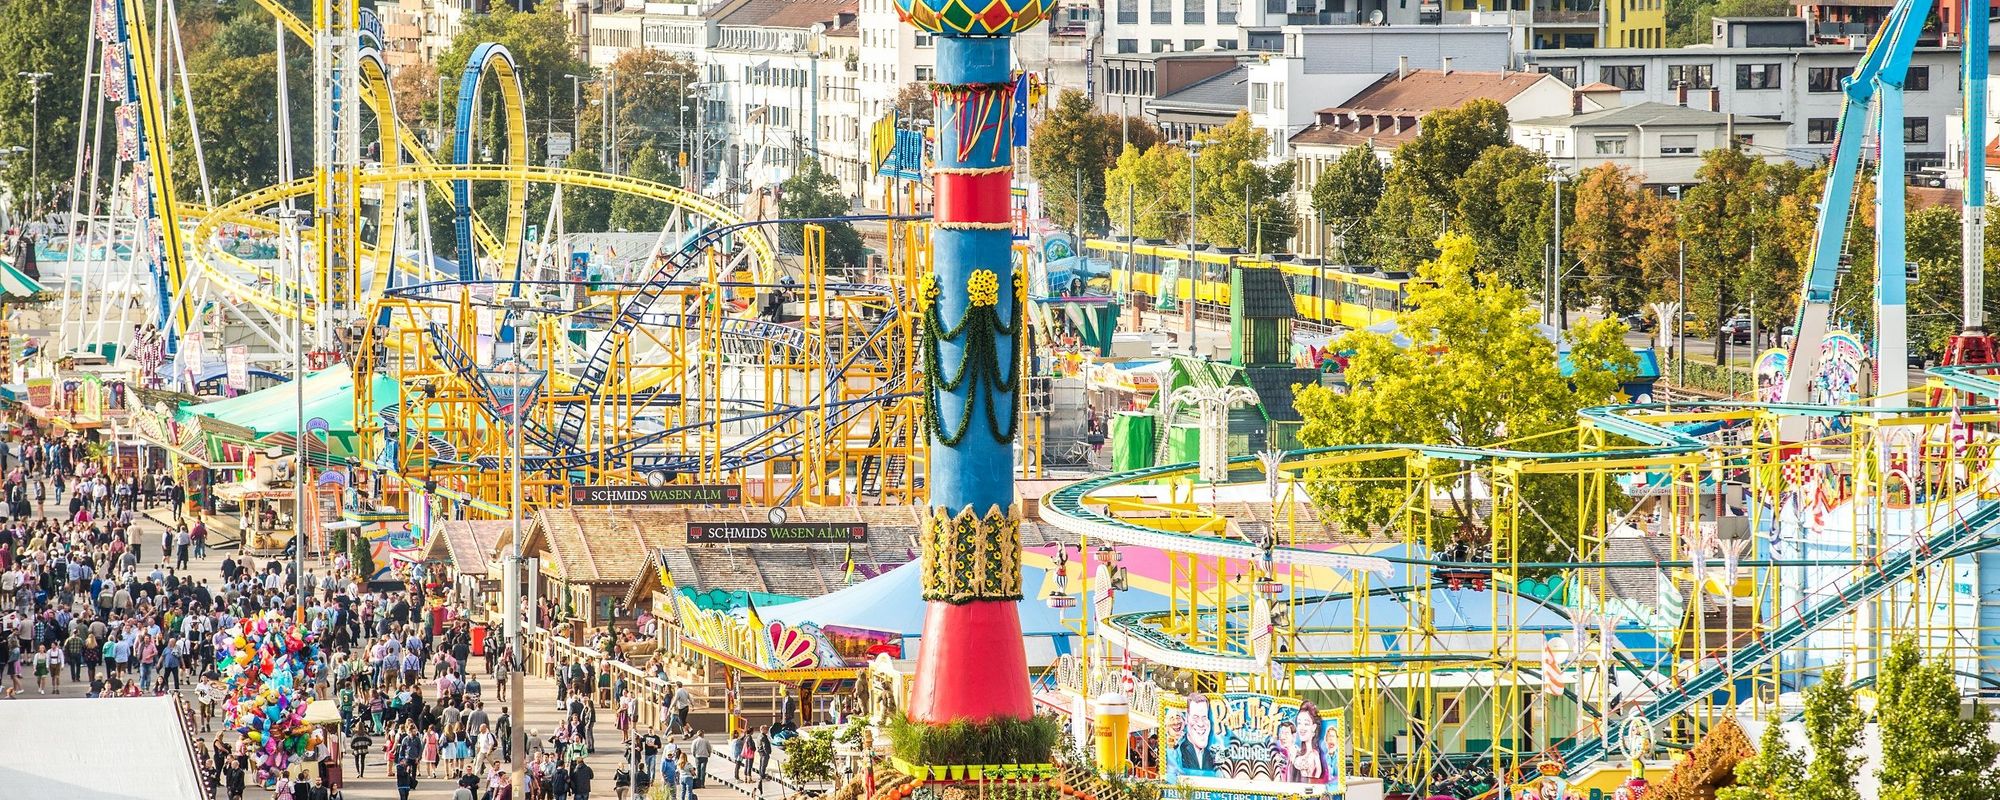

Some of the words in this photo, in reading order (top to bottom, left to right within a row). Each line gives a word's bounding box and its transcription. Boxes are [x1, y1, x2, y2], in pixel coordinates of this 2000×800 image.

[591, 490, 647, 501] SCHMIDS
[649, 490, 692, 500] WASEN
[694, 489, 721, 500] ALM
[708, 527, 767, 539] SCHMIDS
[769, 527, 815, 539] WASEN
[817, 527, 846, 538] ALM
[1231, 746, 1271, 760] LOUNGE
[1195, 791, 1211, 800] DIE
